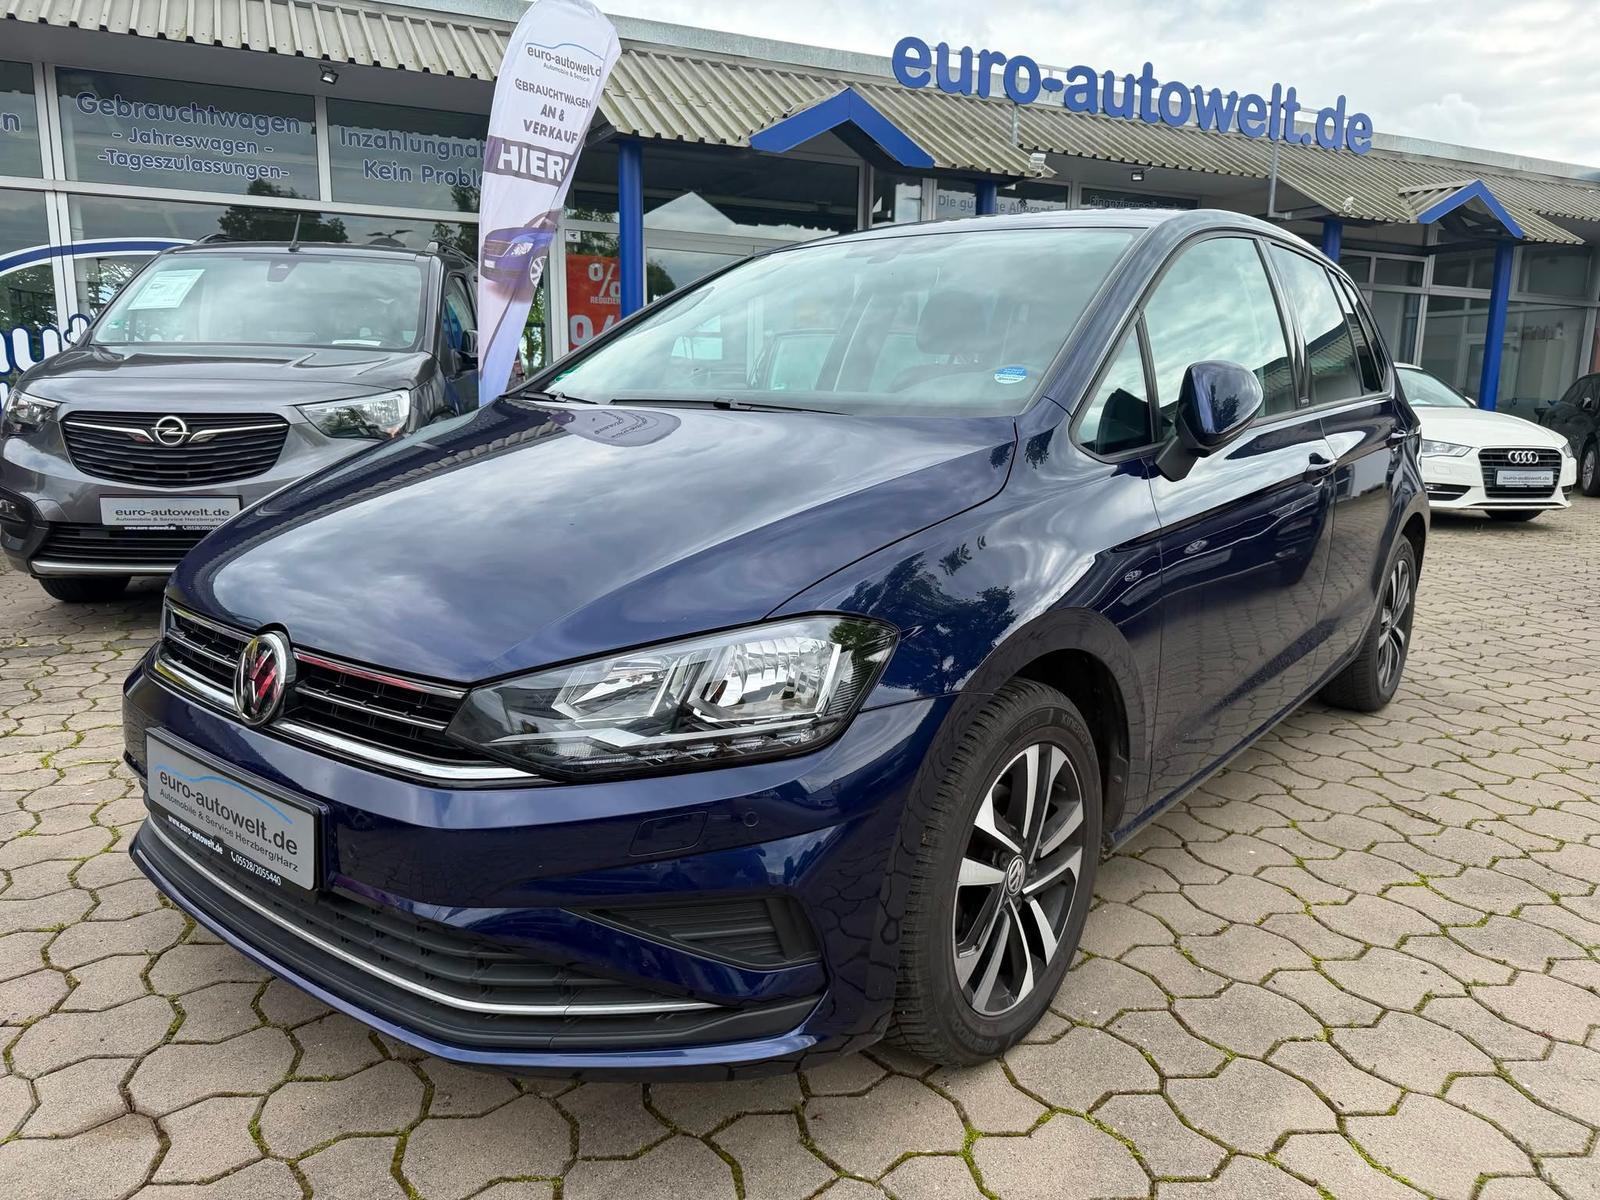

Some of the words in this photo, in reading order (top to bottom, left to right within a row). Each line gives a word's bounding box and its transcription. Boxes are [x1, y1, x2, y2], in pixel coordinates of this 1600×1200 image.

[892, 36, 1373, 155] euro-autowelt.de
[76, 91, 301, 136] Gebrauchtwagen
[540, 103, 557, 120] AN
[558, 108, 565, 122] &
[128, 127, 258, 155] Jahreswagen
[523, 119, 579, 144] VERKAUF
[363, 159, 412, 183] Kein
[498, 143, 570, 182] HIER!
[938, 195, 956, 207] Die
[115, 508, 230, 517] euro-autowelt.de
[160, 771, 298, 855] euro-autowelt.de
[160, 788, 197, 816] Automobile
[205, 814, 234, 838] Service
[235, 831, 299, 873] Herzberg/Harz
[167, 814, 223, 855] www.euro-autowelt.de
